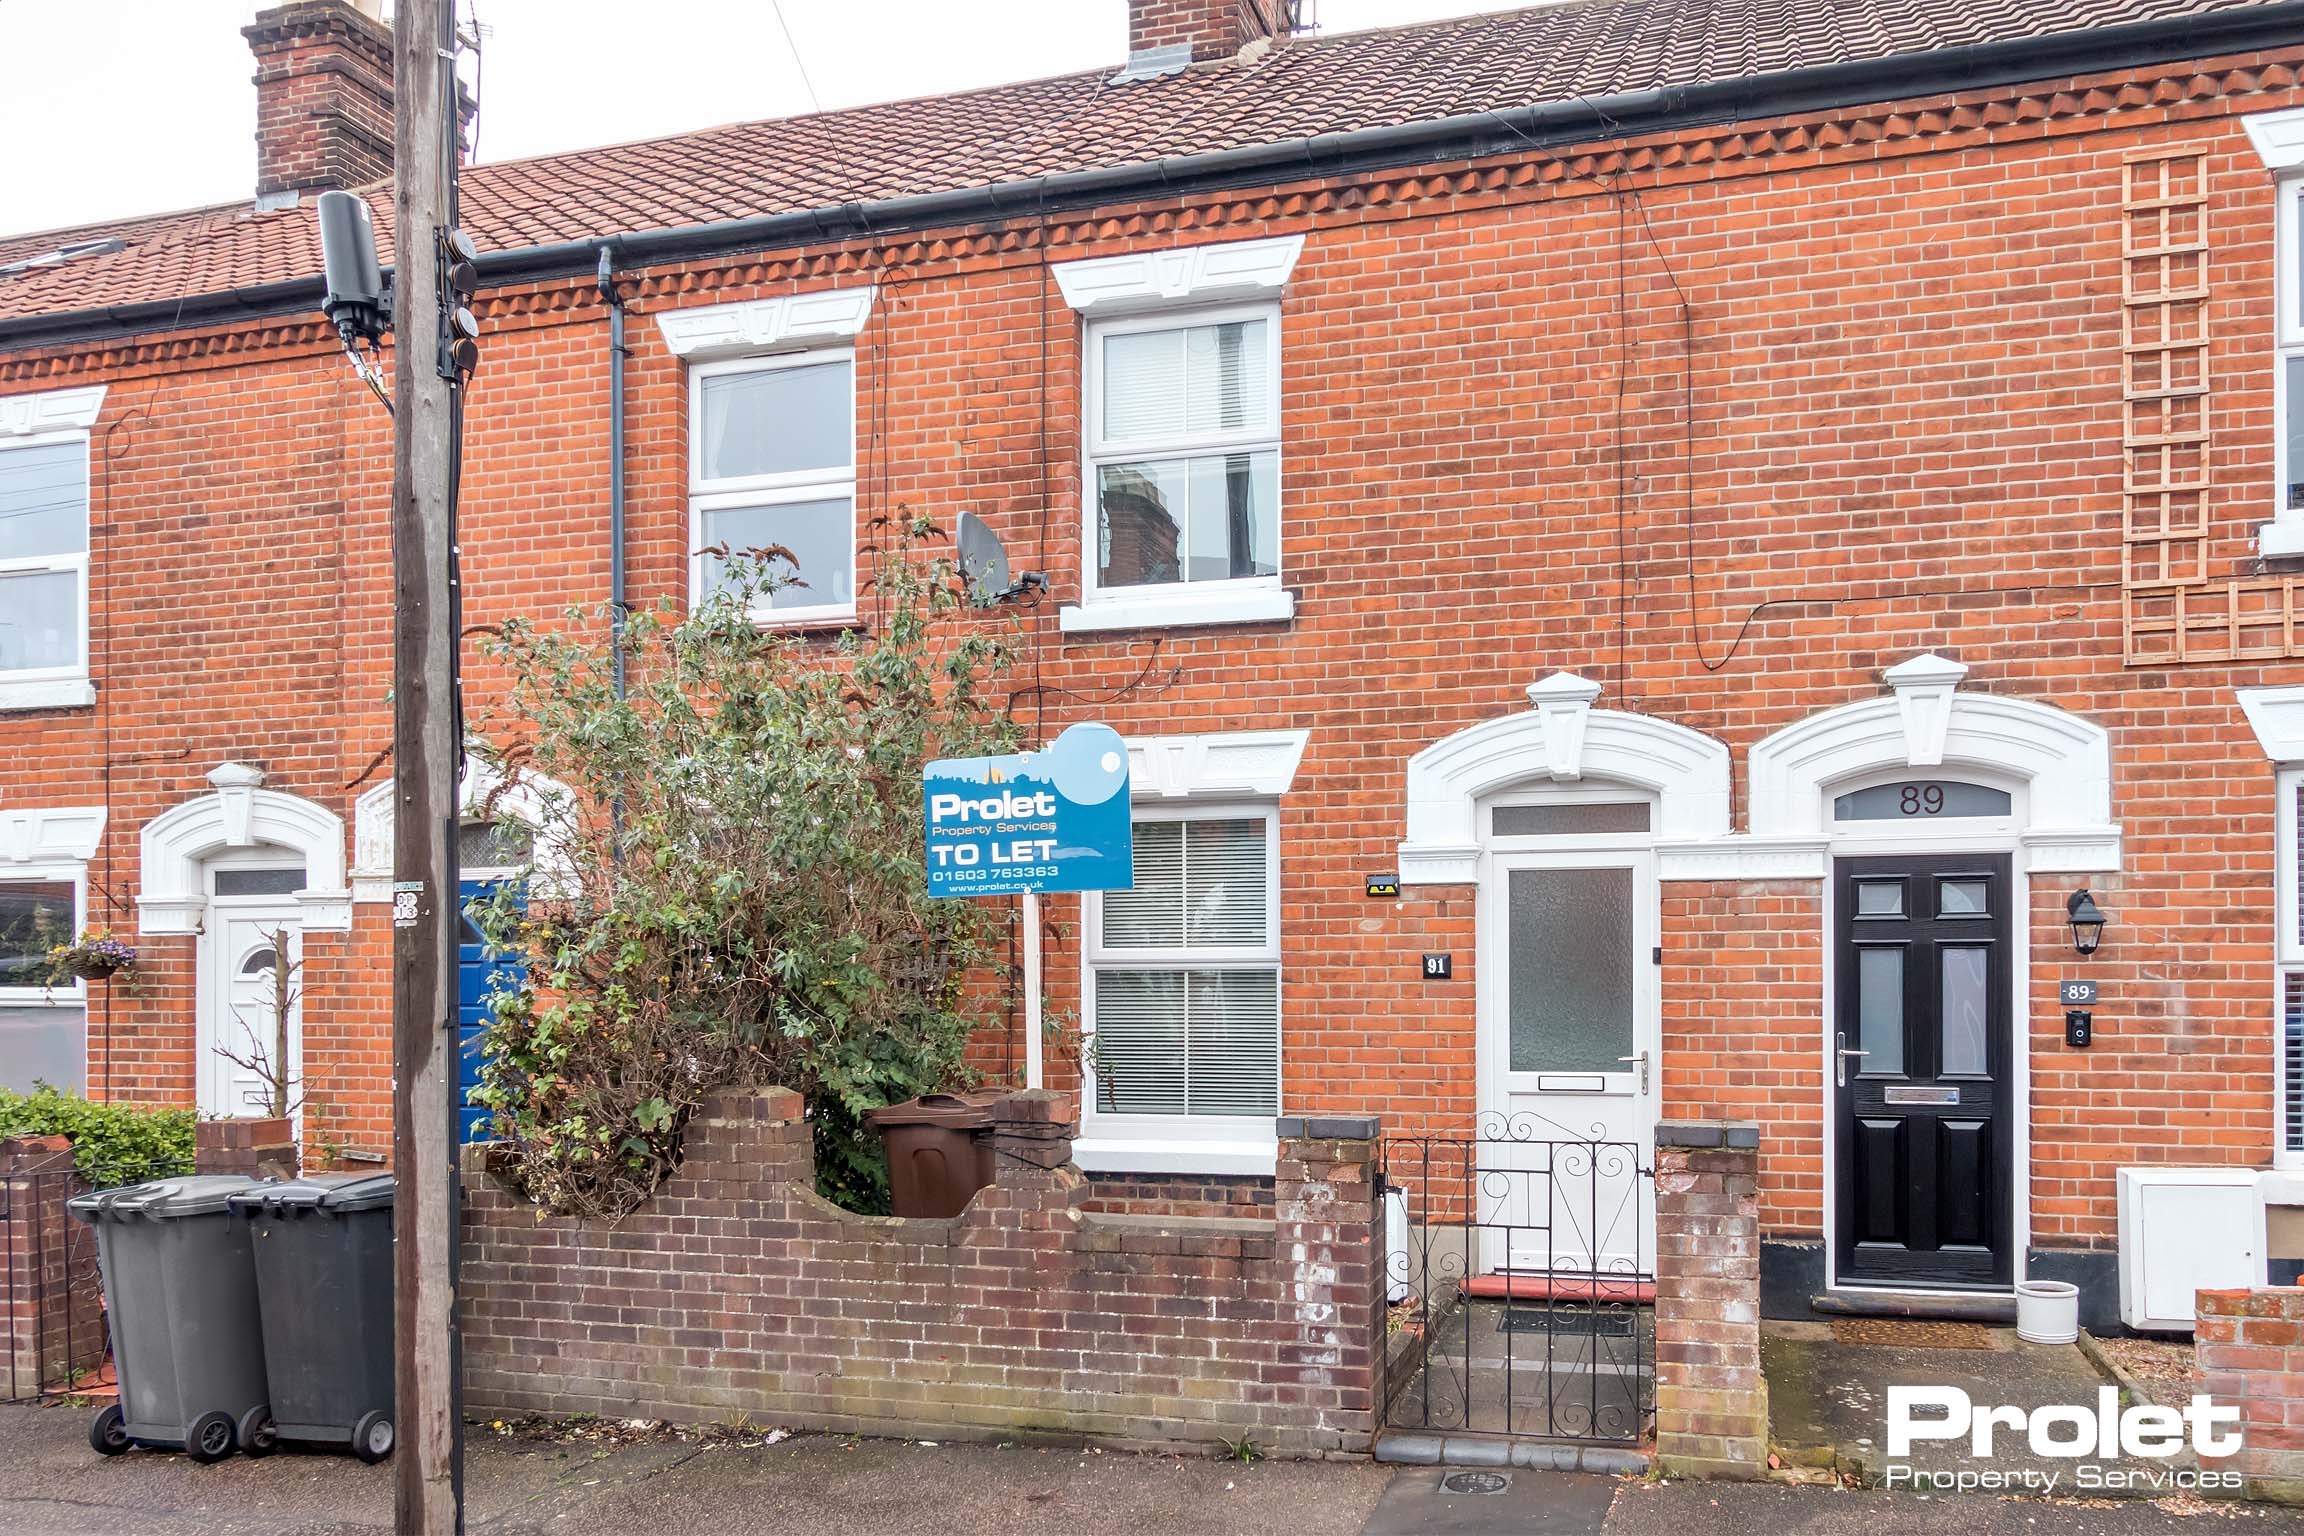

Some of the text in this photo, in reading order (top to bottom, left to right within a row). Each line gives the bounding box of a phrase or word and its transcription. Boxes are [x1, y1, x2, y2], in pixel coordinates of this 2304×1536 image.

[931, 790, 1056, 823] Prolet
[1900, 784, 1944, 815] 89
[932, 822, 1057, 837] Property Services
[931, 839, 1057, 866] TO LET
[932, 866, 1058, 882] 01603 763363
[949, 881, 1044, 893] www.prolet.co.uk
[1427, 958, 1445, 974] 91
